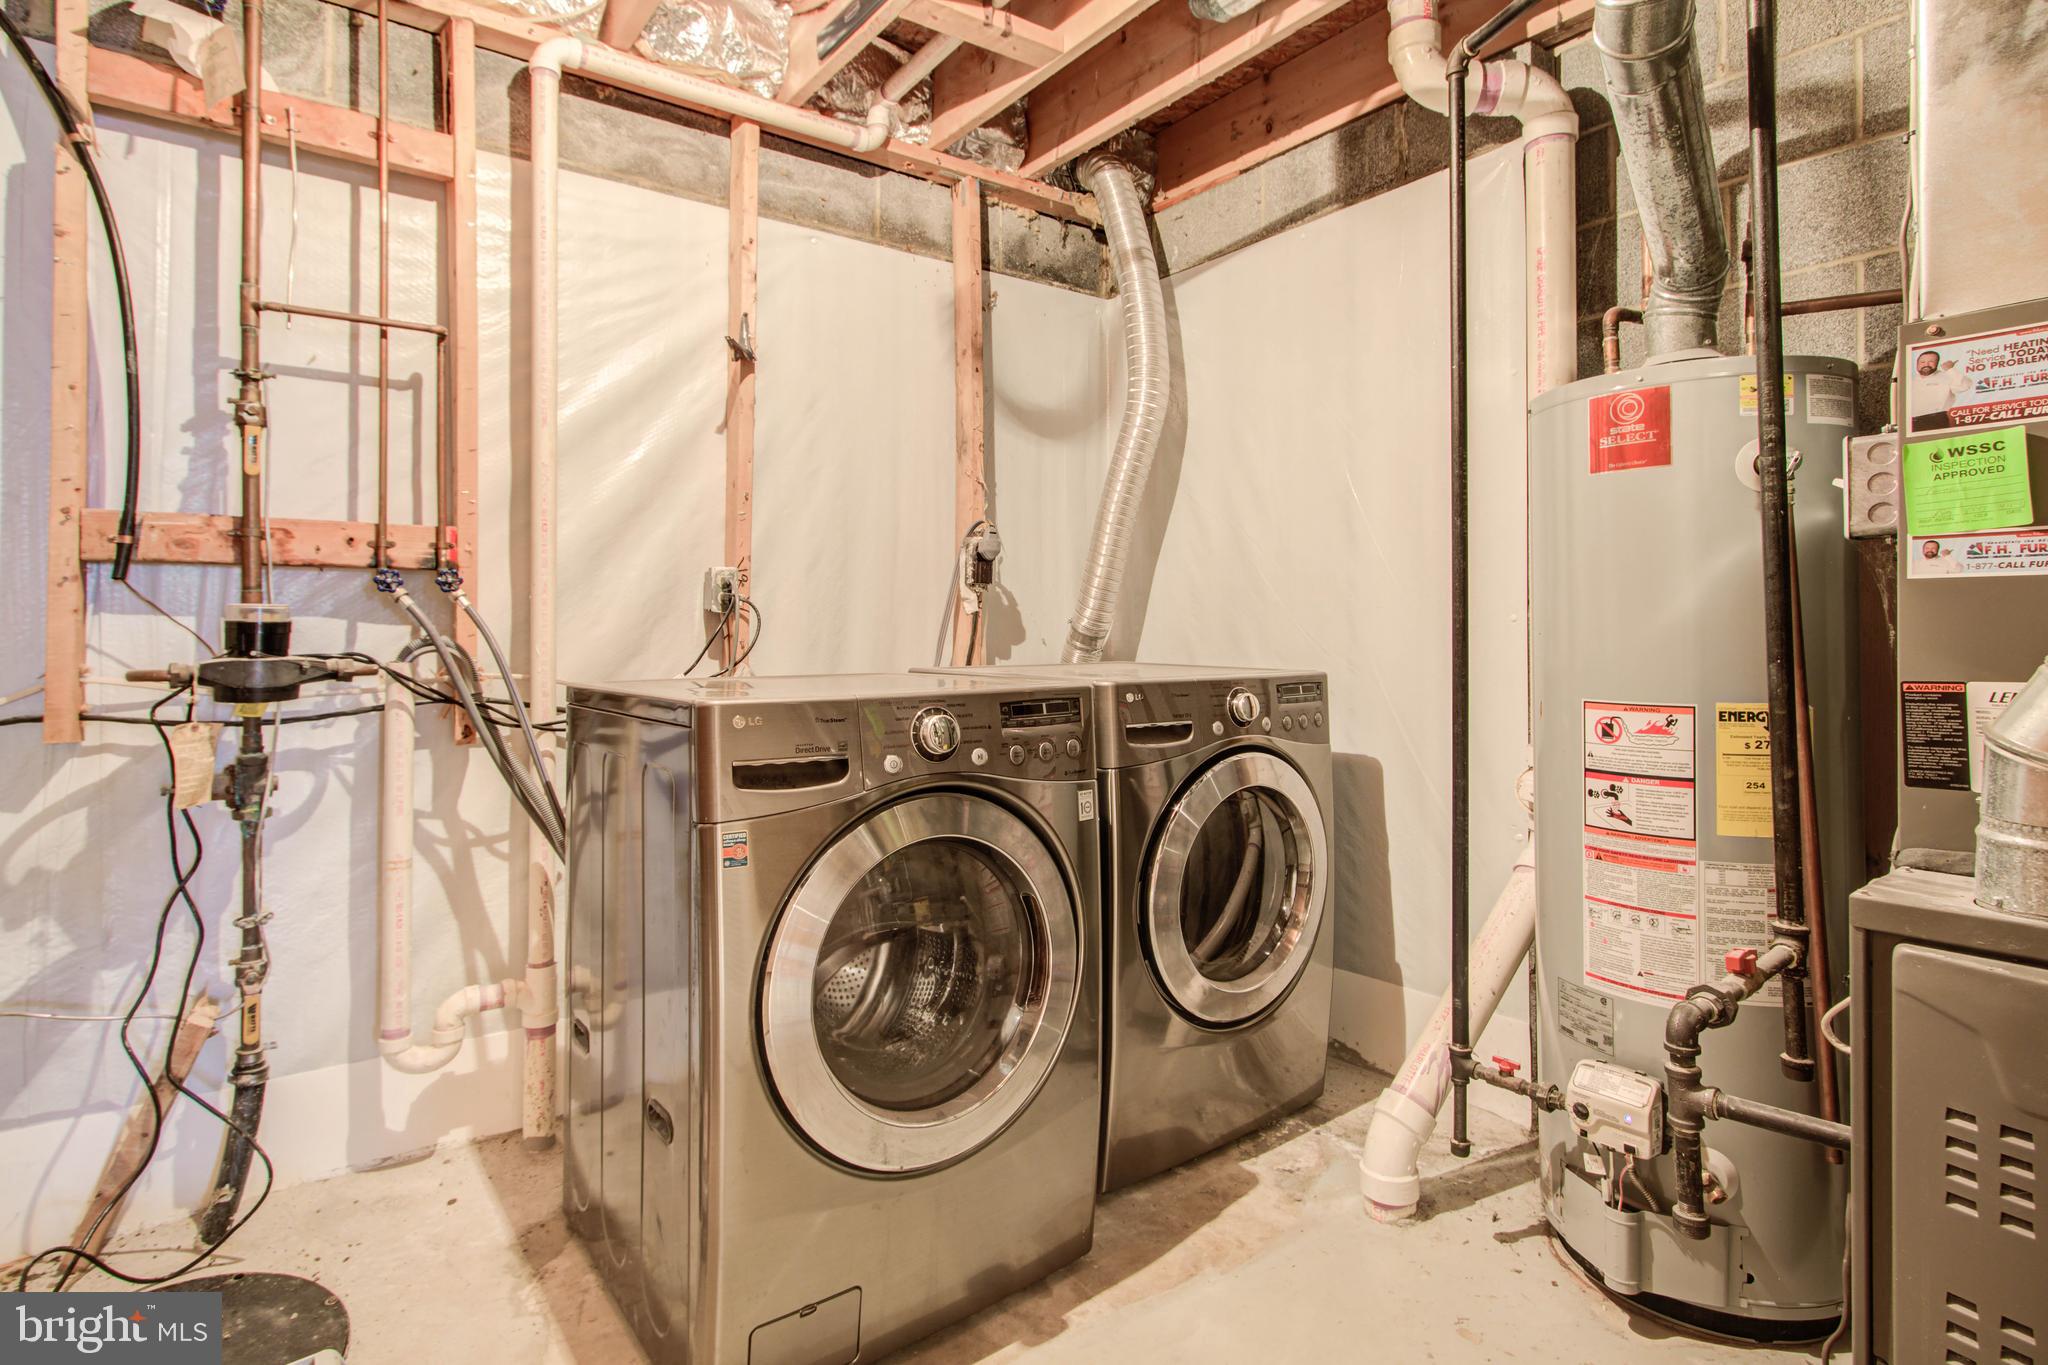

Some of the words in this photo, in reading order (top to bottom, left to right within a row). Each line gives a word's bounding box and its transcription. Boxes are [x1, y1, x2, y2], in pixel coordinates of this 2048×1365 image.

[1968, 355, 2005, 364] Service
[1966, 364, 1986, 373] NO
[1992, 377, 2016, 388] F.H.
[1950, 409, 1971, 417] CALL
[1972, 406, 1990, 414] FOR
[1992, 401, 2027, 412] SERVICE
[1610, 423, 1645, 435] state
[1600, 430, 1659, 446] SELECT
[1947, 440, 2006, 457] WSSC
[1931, 455, 2006, 472] INSPECTION
[1933, 465, 2005, 481] APPROVED
[1984, 545, 2012, 554] F.H.
[749, 717, 763, 726] LG
